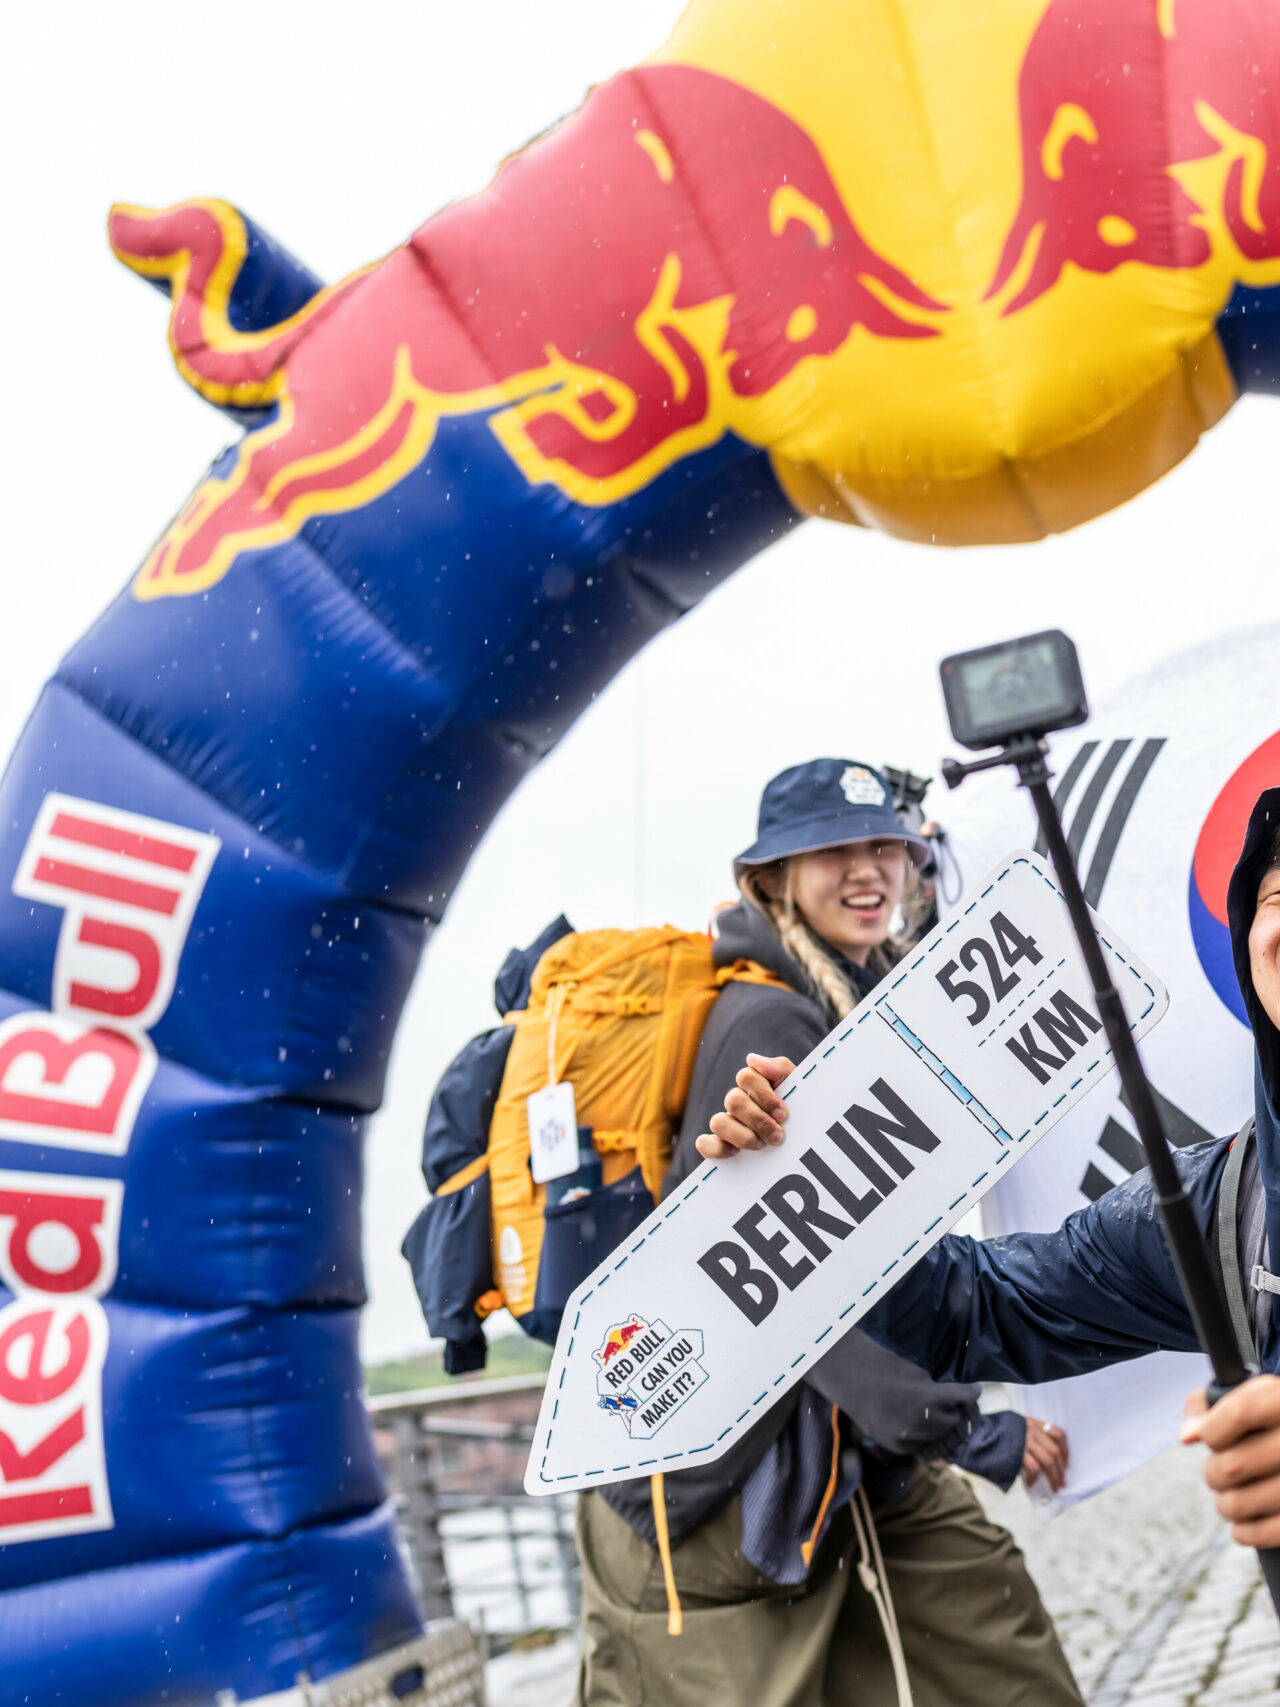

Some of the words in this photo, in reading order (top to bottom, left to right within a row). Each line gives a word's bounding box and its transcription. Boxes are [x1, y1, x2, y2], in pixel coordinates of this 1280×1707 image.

[935, 911, 1044, 1027] 524
[1005, 989, 1104, 1086] KM
[697, 1077, 942, 1328] BERLIN
[605, 1359, 634, 1388] RED
[630, 1330, 666, 1364] BULL
[641, 1363, 669, 1391] CAN
[663, 1338, 693, 1368] YOU
[641, 1389, 679, 1428] MAKE
[673, 1372, 695, 1396] IT?
